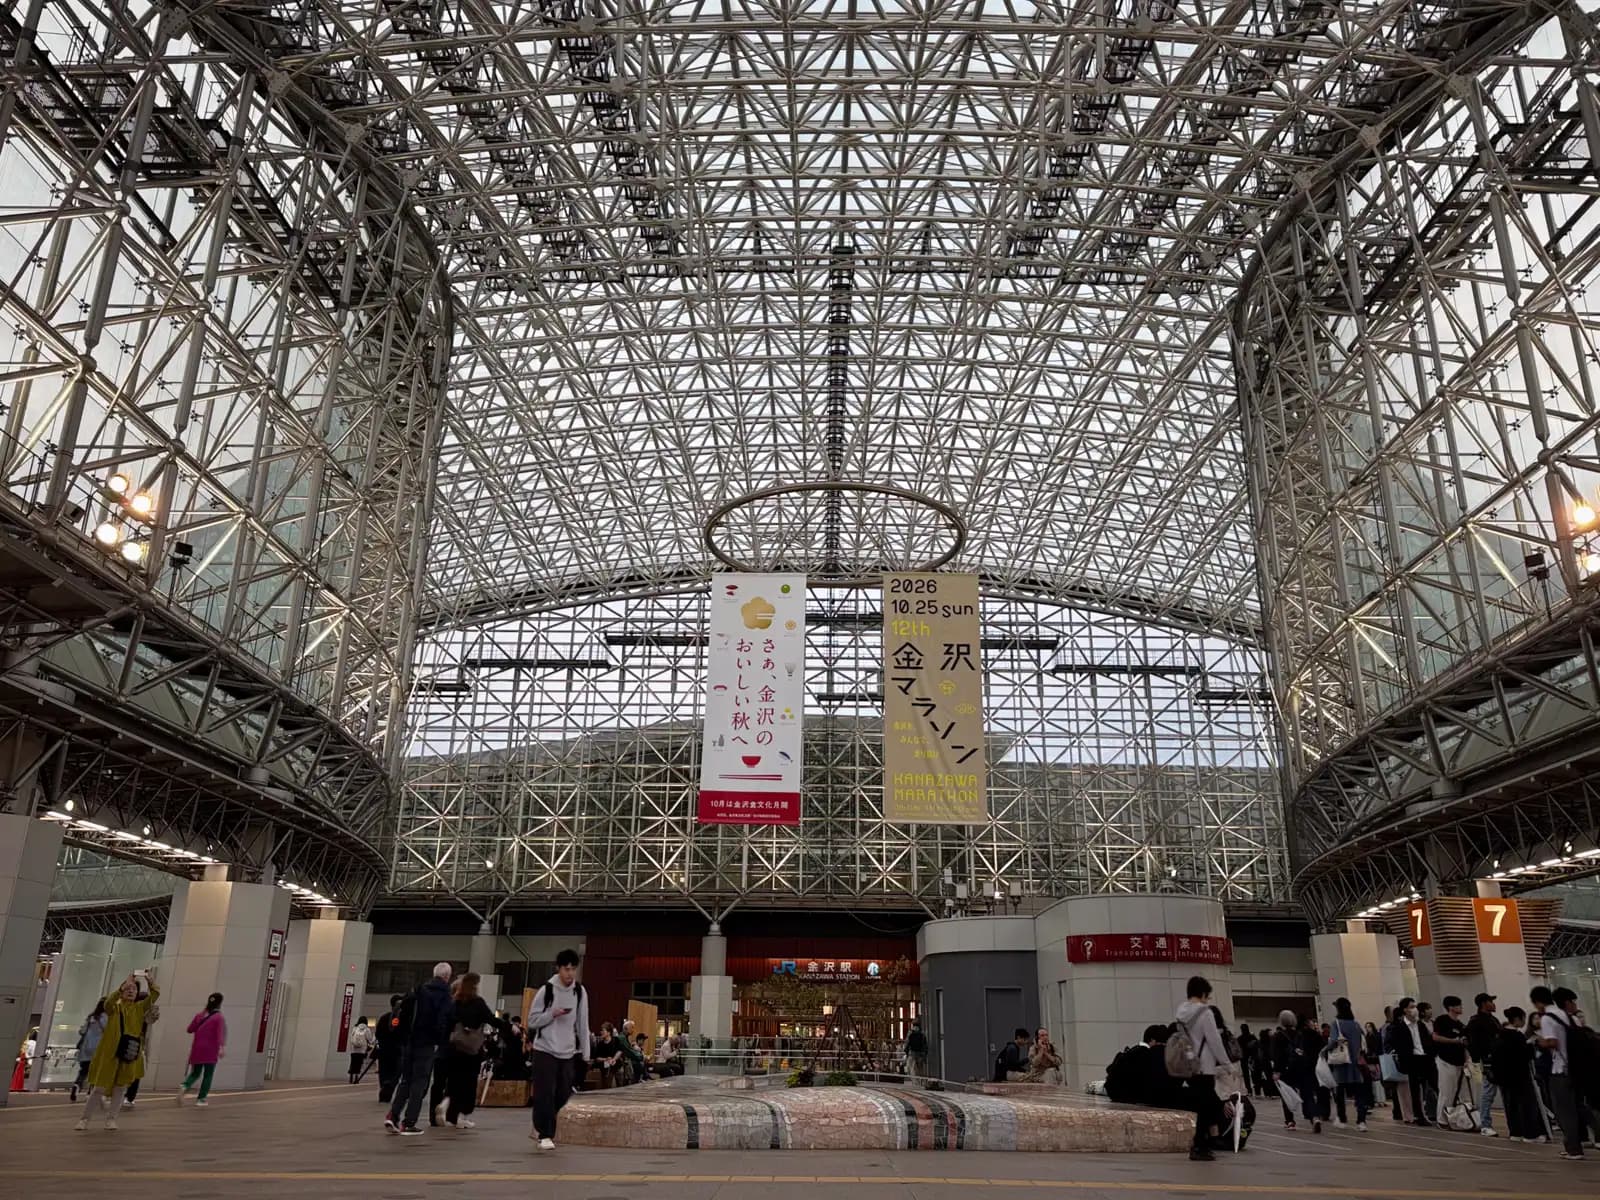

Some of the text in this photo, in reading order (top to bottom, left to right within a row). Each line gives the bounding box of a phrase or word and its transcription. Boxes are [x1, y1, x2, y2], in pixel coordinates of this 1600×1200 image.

[890, 578, 937, 594] 2026
[891, 599, 974, 619] 10.25 sun
[891, 620, 931, 638] 12th
[891, 641, 976, 671] 金沢
[731, 638, 753, 746] おいしい秋へ
[891, 677, 979, 764] マラソン
[894, 772, 978, 787] KANAZAWA
[894, 788, 979, 803] MARATHON
[1411, 908, 1423, 941] 7
[1484, 904, 1507, 937] 7
[773, 960, 797, 975] JR
[807, 961, 852, 972] 金沢駅
